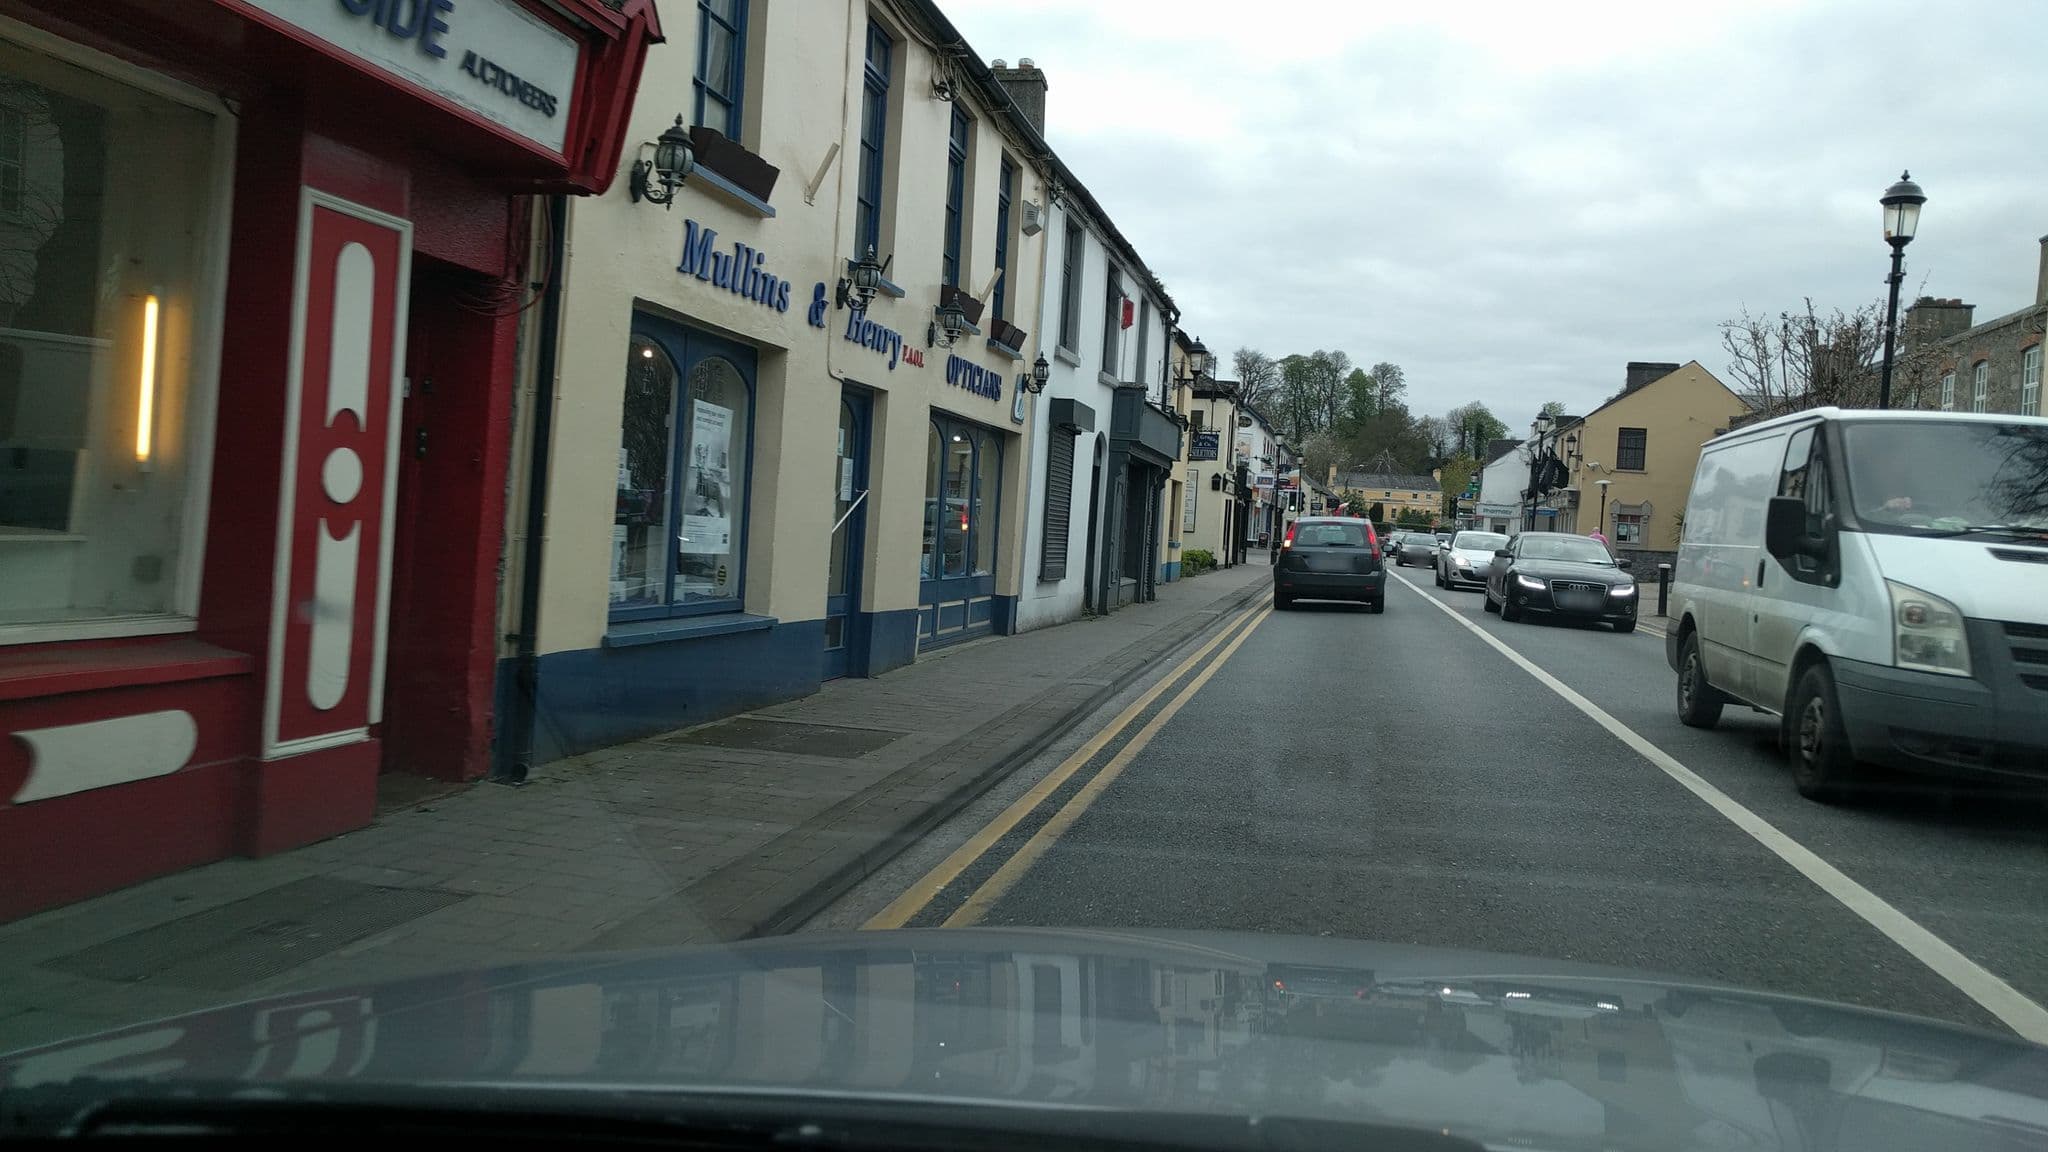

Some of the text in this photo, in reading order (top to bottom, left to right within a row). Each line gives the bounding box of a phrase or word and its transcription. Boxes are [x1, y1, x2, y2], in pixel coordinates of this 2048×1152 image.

[339, 0, 557, 118] IDE AUCTIONEERS
[676, 218, 791, 313] Mullins
[808, 281, 829, 328] &
[844, 309, 903, 371] Henry
[946, 353, 1002, 402] OPTICIANS
